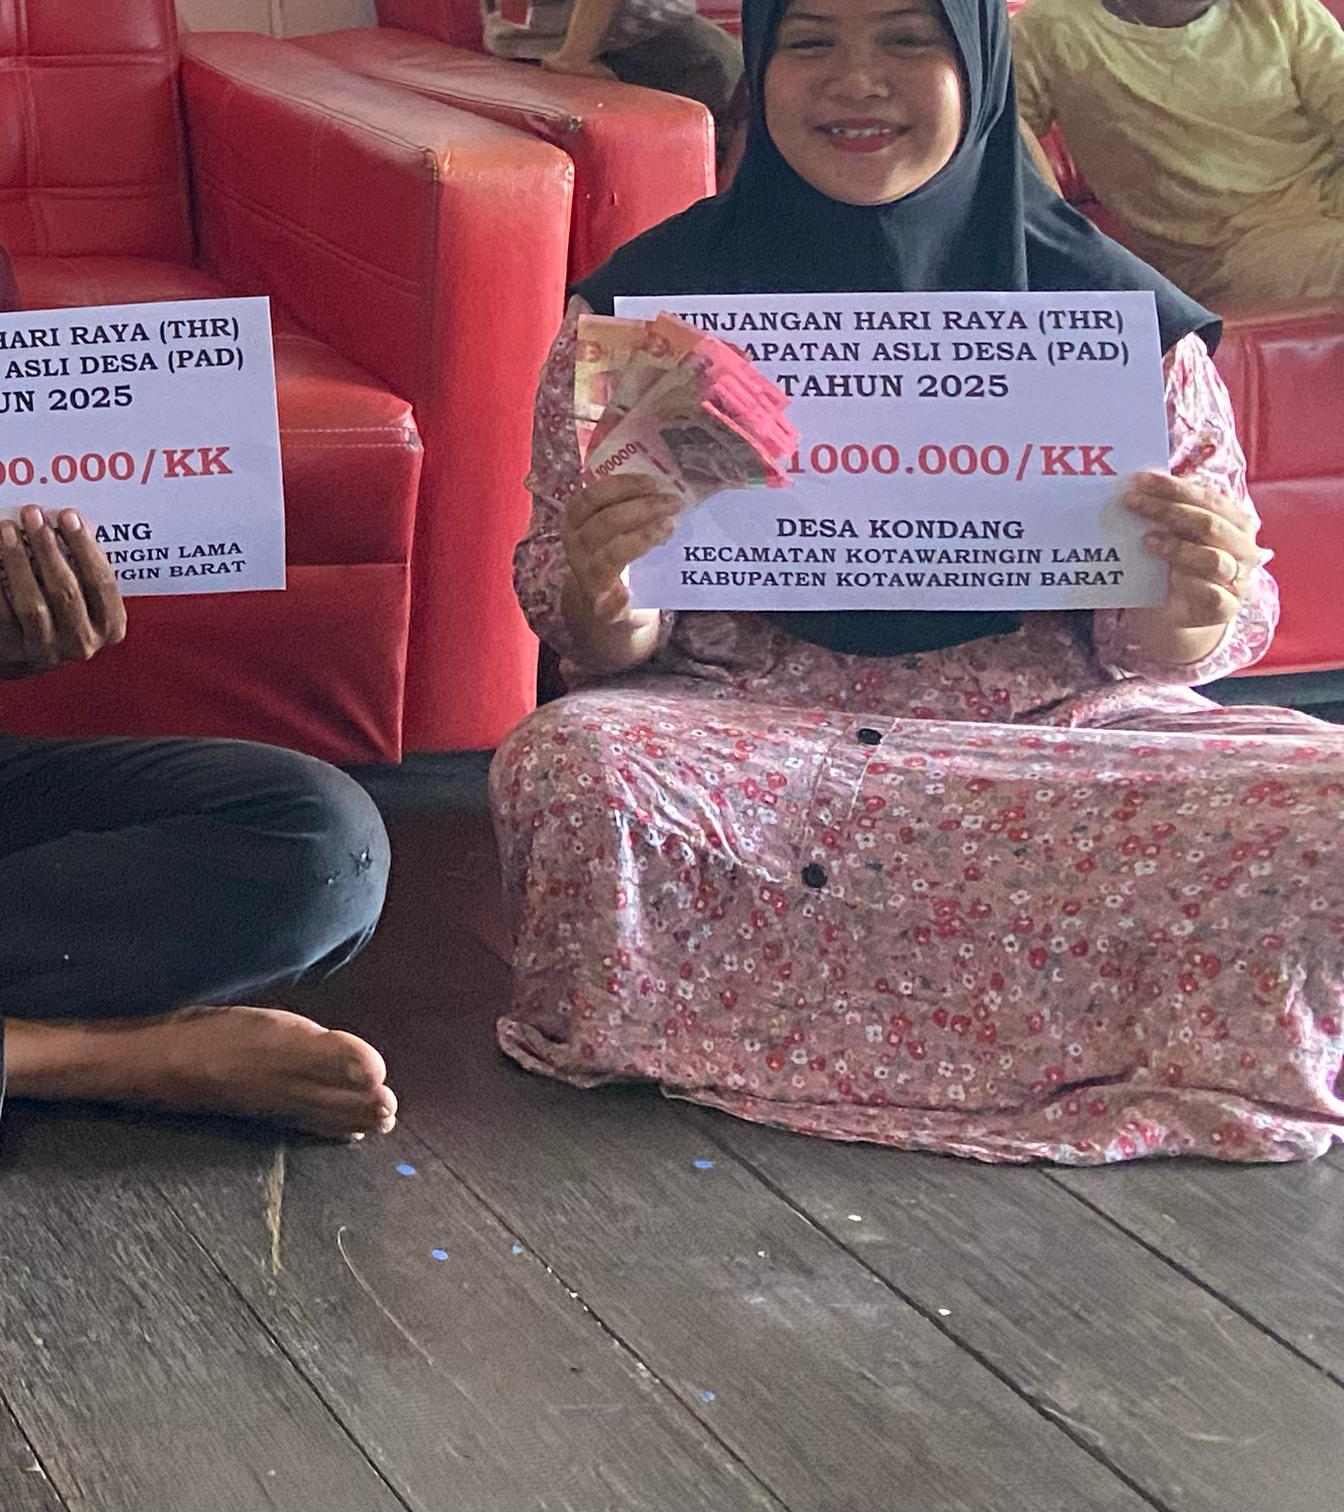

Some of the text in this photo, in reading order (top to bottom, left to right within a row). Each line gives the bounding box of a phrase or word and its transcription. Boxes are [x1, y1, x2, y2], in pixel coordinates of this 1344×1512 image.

[69, 322, 150, 345] RAYA
[159, 316, 239, 345] (THR)
[853, 311, 932, 330] HARI
[942, 310, 1028, 330] RAYA
[1038, 309, 1123, 335] (THR)
[4, 357, 70, 379] ASLI
[79, 352, 159, 375] DESA
[168, 346, 243, 374] (PAD)
[744, 340, 1129, 366] APATAN ASLI DESA (PAD)
[48, 384, 133, 411] 2025
[777, 374, 1009, 398] TAHUN 2025
[775, 518, 1024, 539] DESA KONDANG
[178, 542, 242, 558] LAMA
[683, 546, 1120, 564] KECAMATAN KOTAWARINGIN LAMA
[168, 559, 246, 577] BARAT
[680, 570, 1124, 587] KABUPATEN KOTAWARINGIN BARAT
